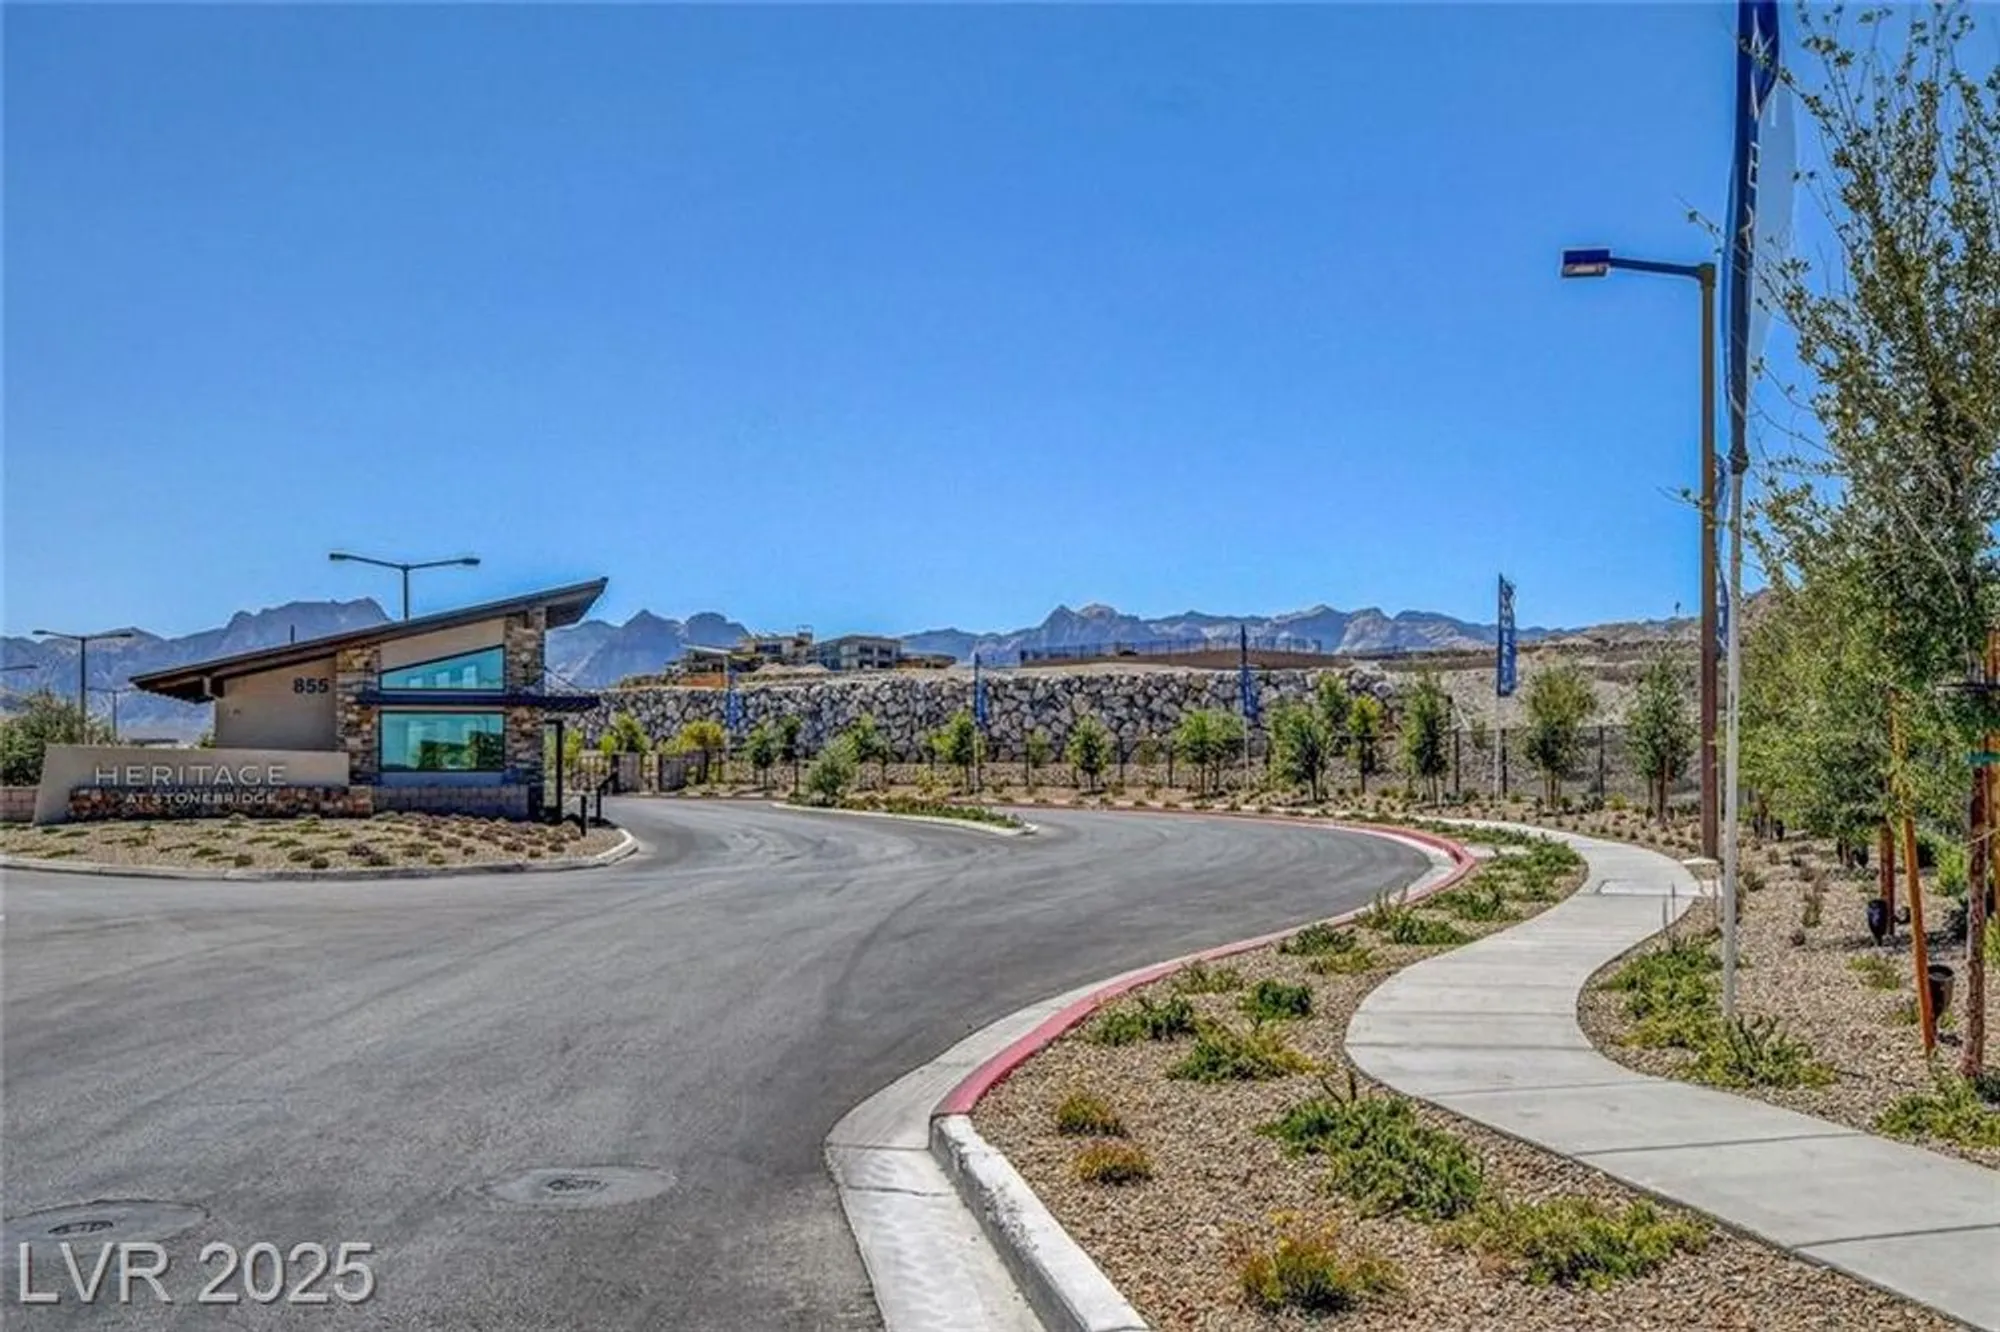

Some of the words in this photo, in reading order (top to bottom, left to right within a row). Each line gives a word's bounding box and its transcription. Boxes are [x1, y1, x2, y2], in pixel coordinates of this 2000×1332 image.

[293, 677, 329, 694] 855
[94, 764, 287, 786] HERITAGE
[125, 792, 147, 804] AT
[150, 792, 278, 805] STONEBRIDGE
